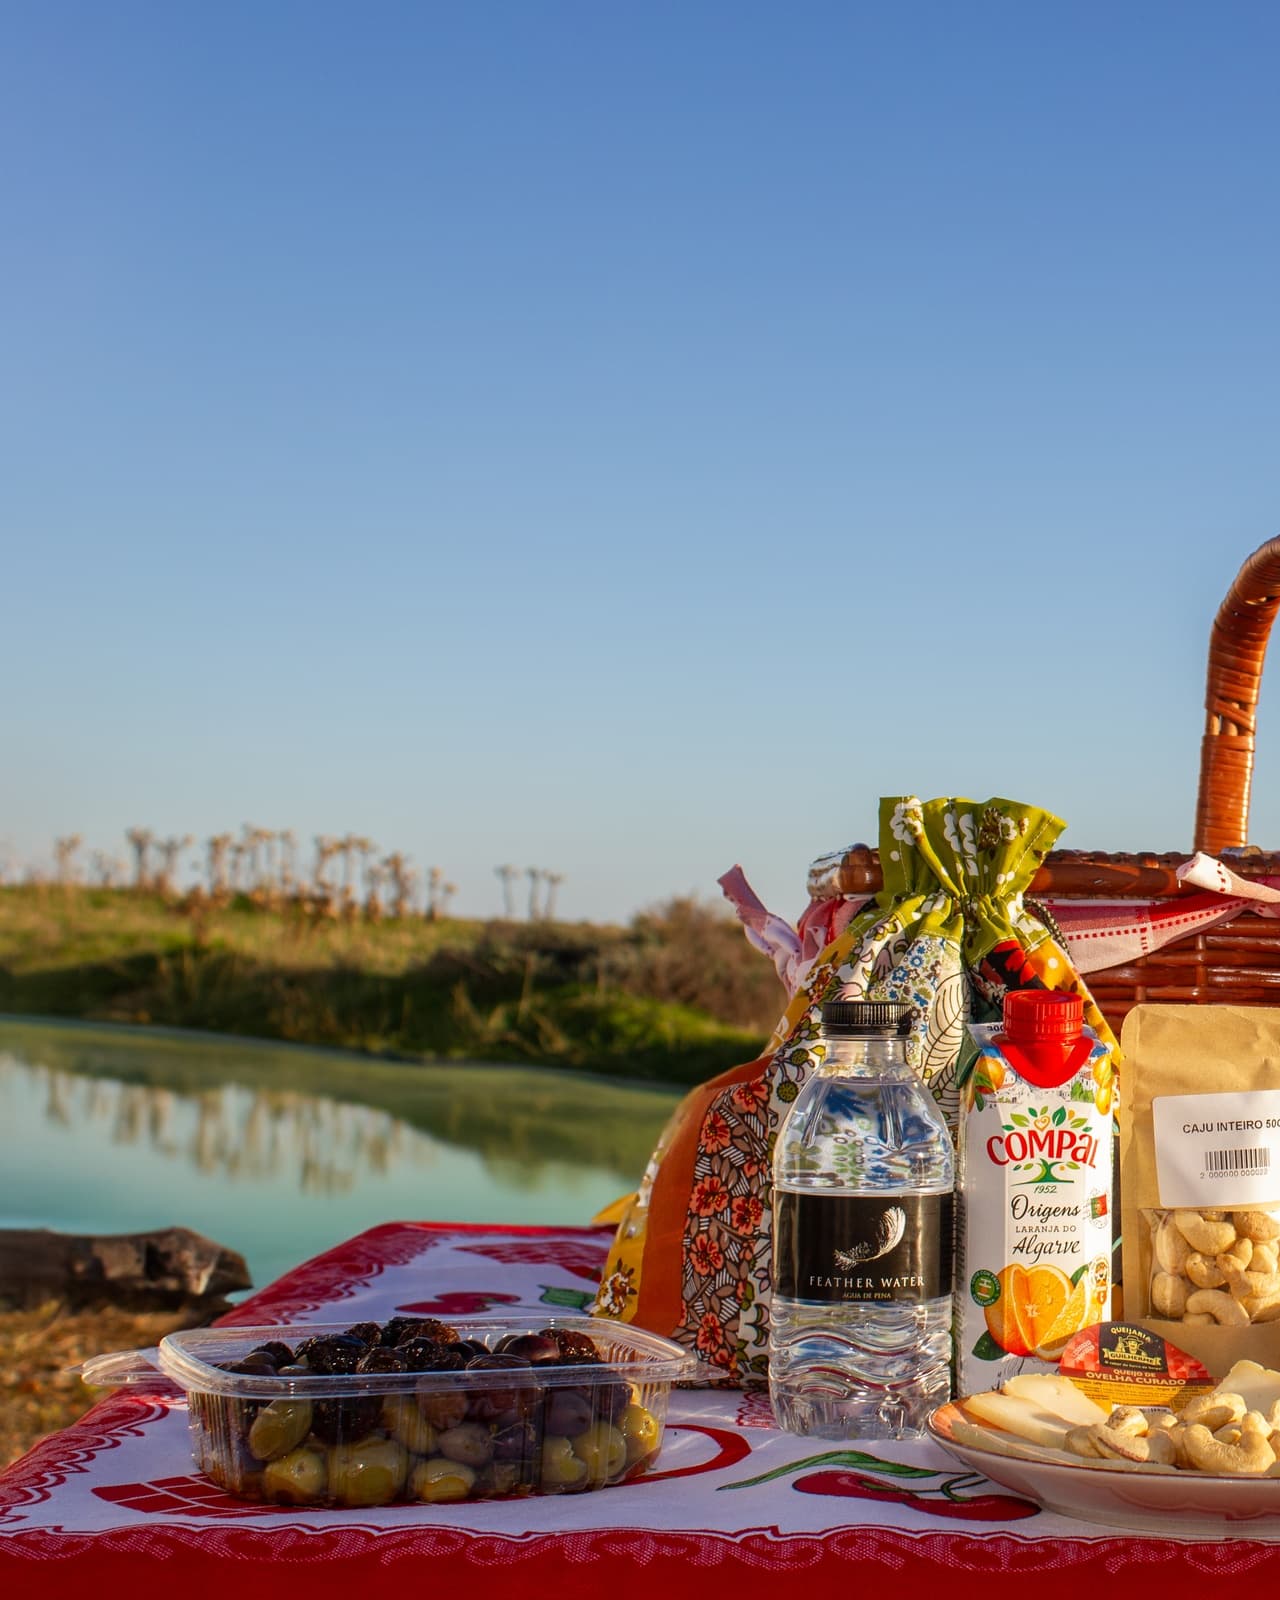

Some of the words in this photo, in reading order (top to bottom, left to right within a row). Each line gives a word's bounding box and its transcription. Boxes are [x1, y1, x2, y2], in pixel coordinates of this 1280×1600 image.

[1182, 1123, 1213, 1134] CAJU
[1217, 1120, 1263, 1132] INTEIRO
[1034, 1186, 1057, 1194] 1952
[1011, 1194, 1080, 1223] Origens
[1012, 1234, 1080, 1264] Algarve
[810, 1276, 874, 1288] FEATHER
[881, 1276, 925, 1288] WATER
[1110, 1326, 1152, 1344] QUEIJARIA
[1086, 1372, 1133, 1383] OVELHA
[1136, 1377, 1186, 1386] CURADO
[1114, 1369, 1142, 1377] QUEIJO
